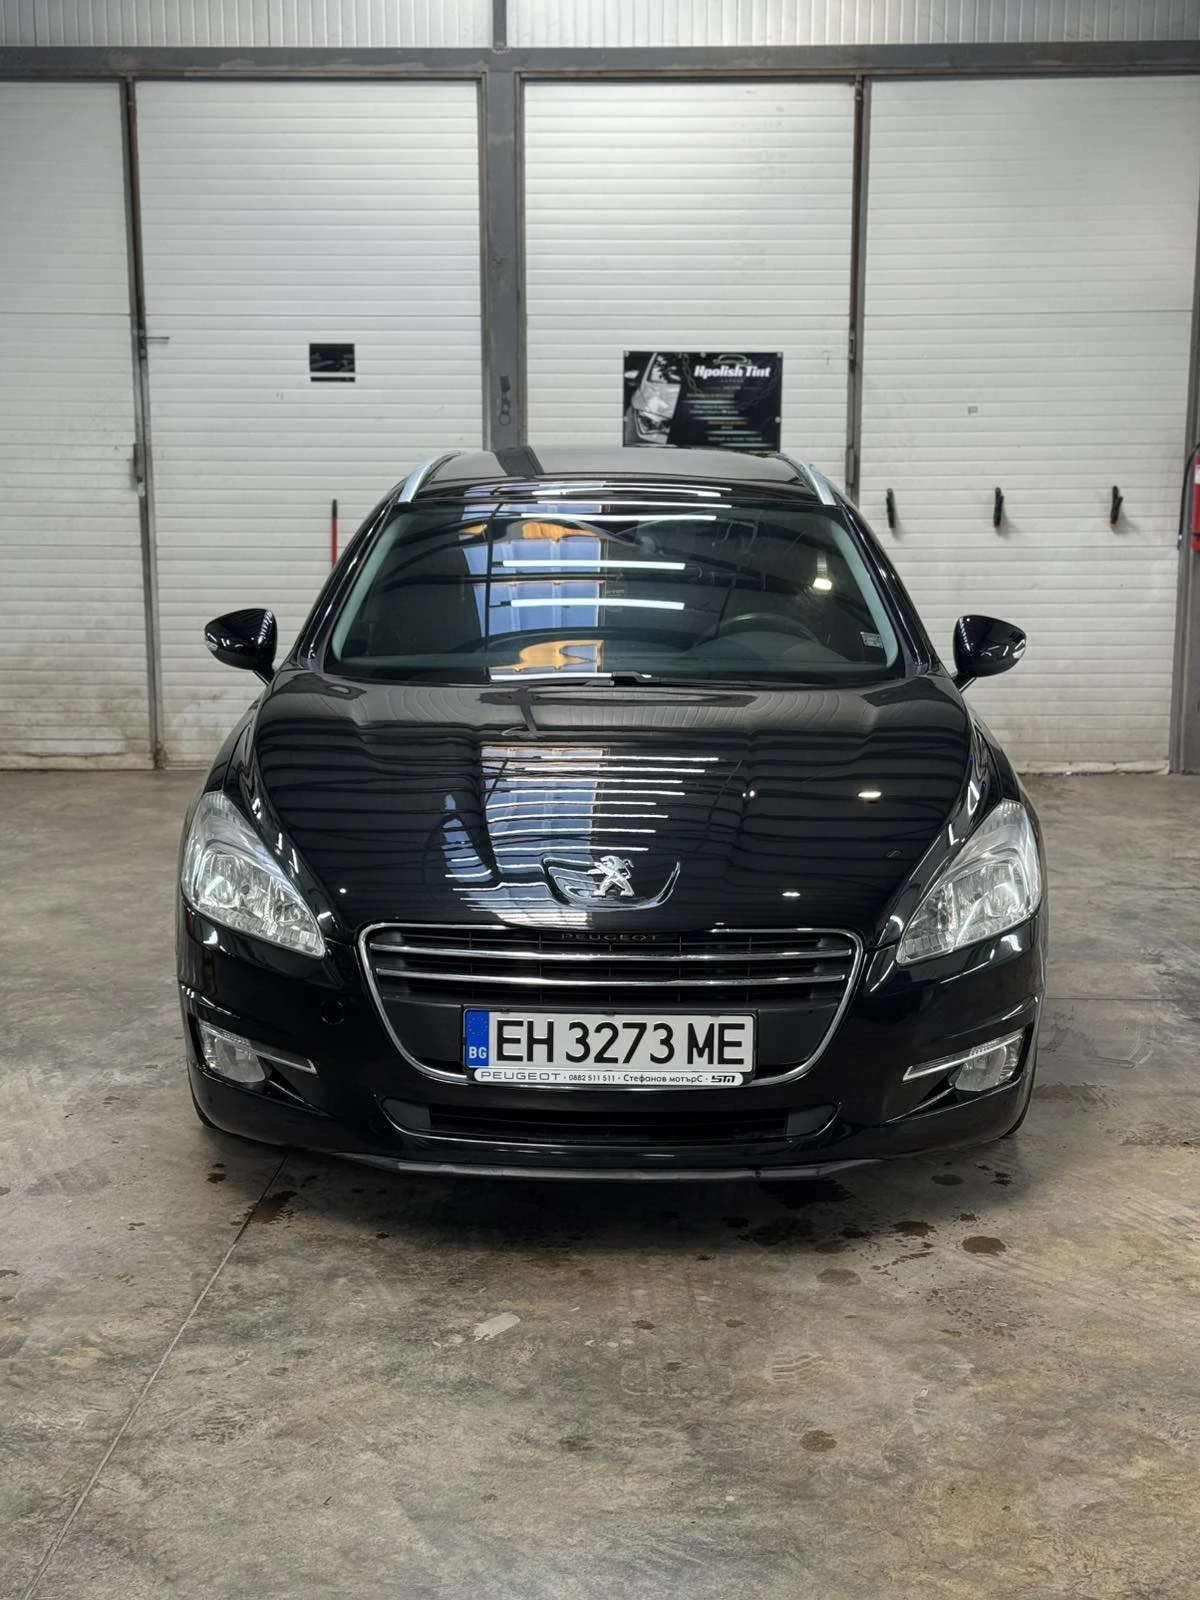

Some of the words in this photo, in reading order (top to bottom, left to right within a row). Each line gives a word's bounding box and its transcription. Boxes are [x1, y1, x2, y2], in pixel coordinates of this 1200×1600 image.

[745, 365, 771, 377] Tint
[496, 1019, 554, 1062] EH
[566, 1021, 675, 1064] 3273
[687, 1022, 745, 1064] ME
[468, 1046, 488, 1059] BG
[480, 1071, 561, 1081] PEUGEOT
[623, 1073, 667, 1083] Стефанов
